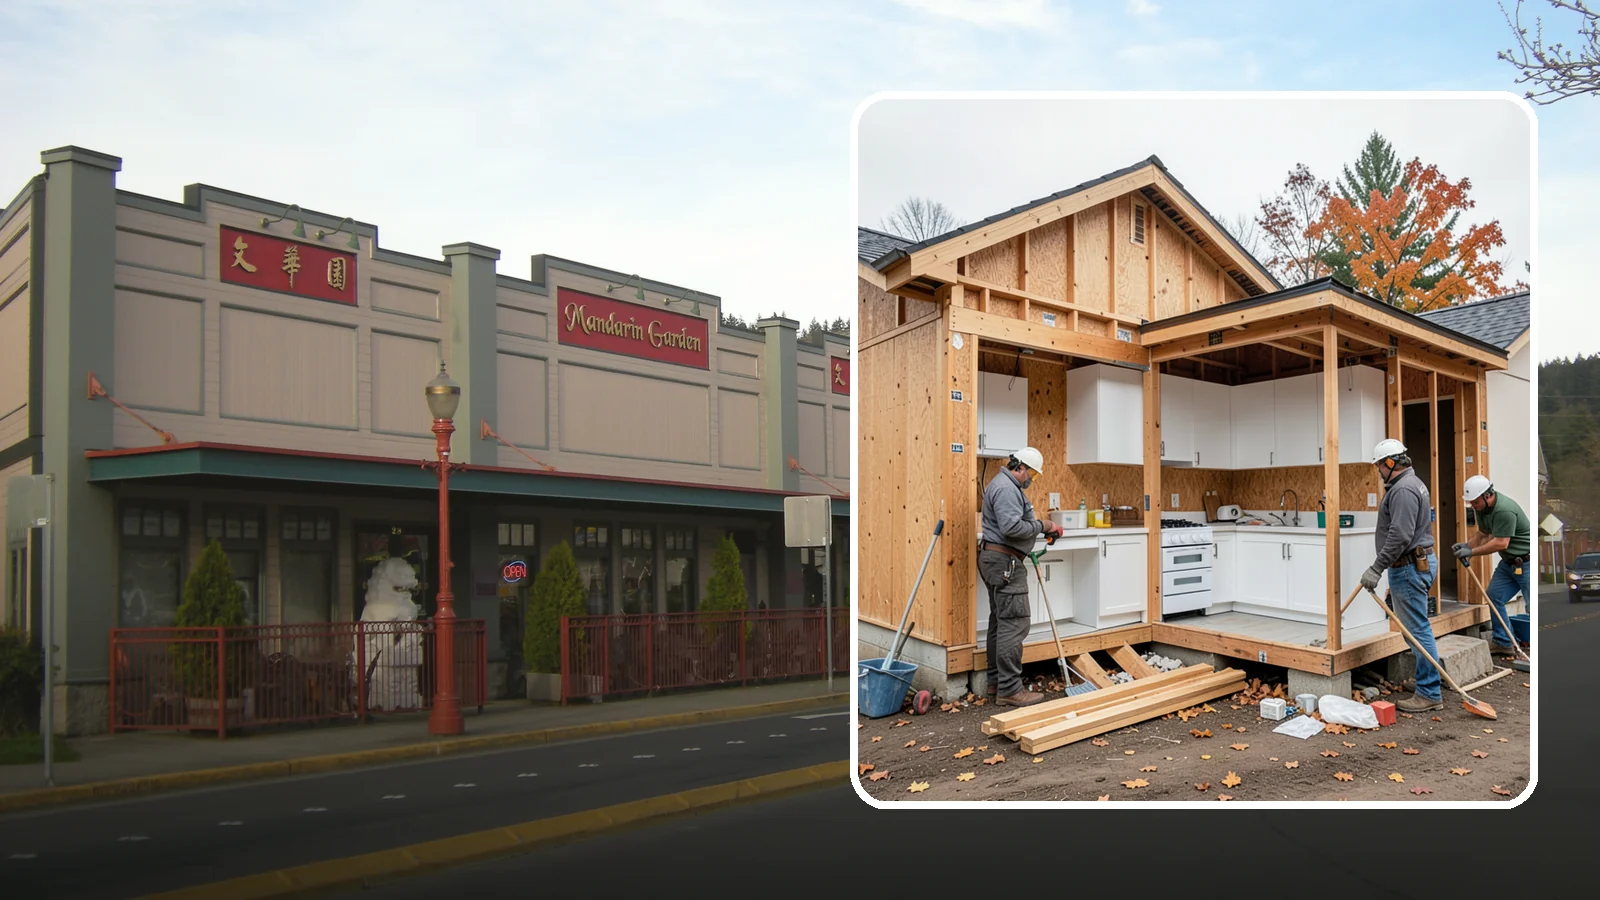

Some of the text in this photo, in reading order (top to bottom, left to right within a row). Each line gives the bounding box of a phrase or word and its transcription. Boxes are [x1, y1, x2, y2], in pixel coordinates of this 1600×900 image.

[564, 302, 701, 352] Mandarin Garden
[503, 564, 527, 578] OPEN
